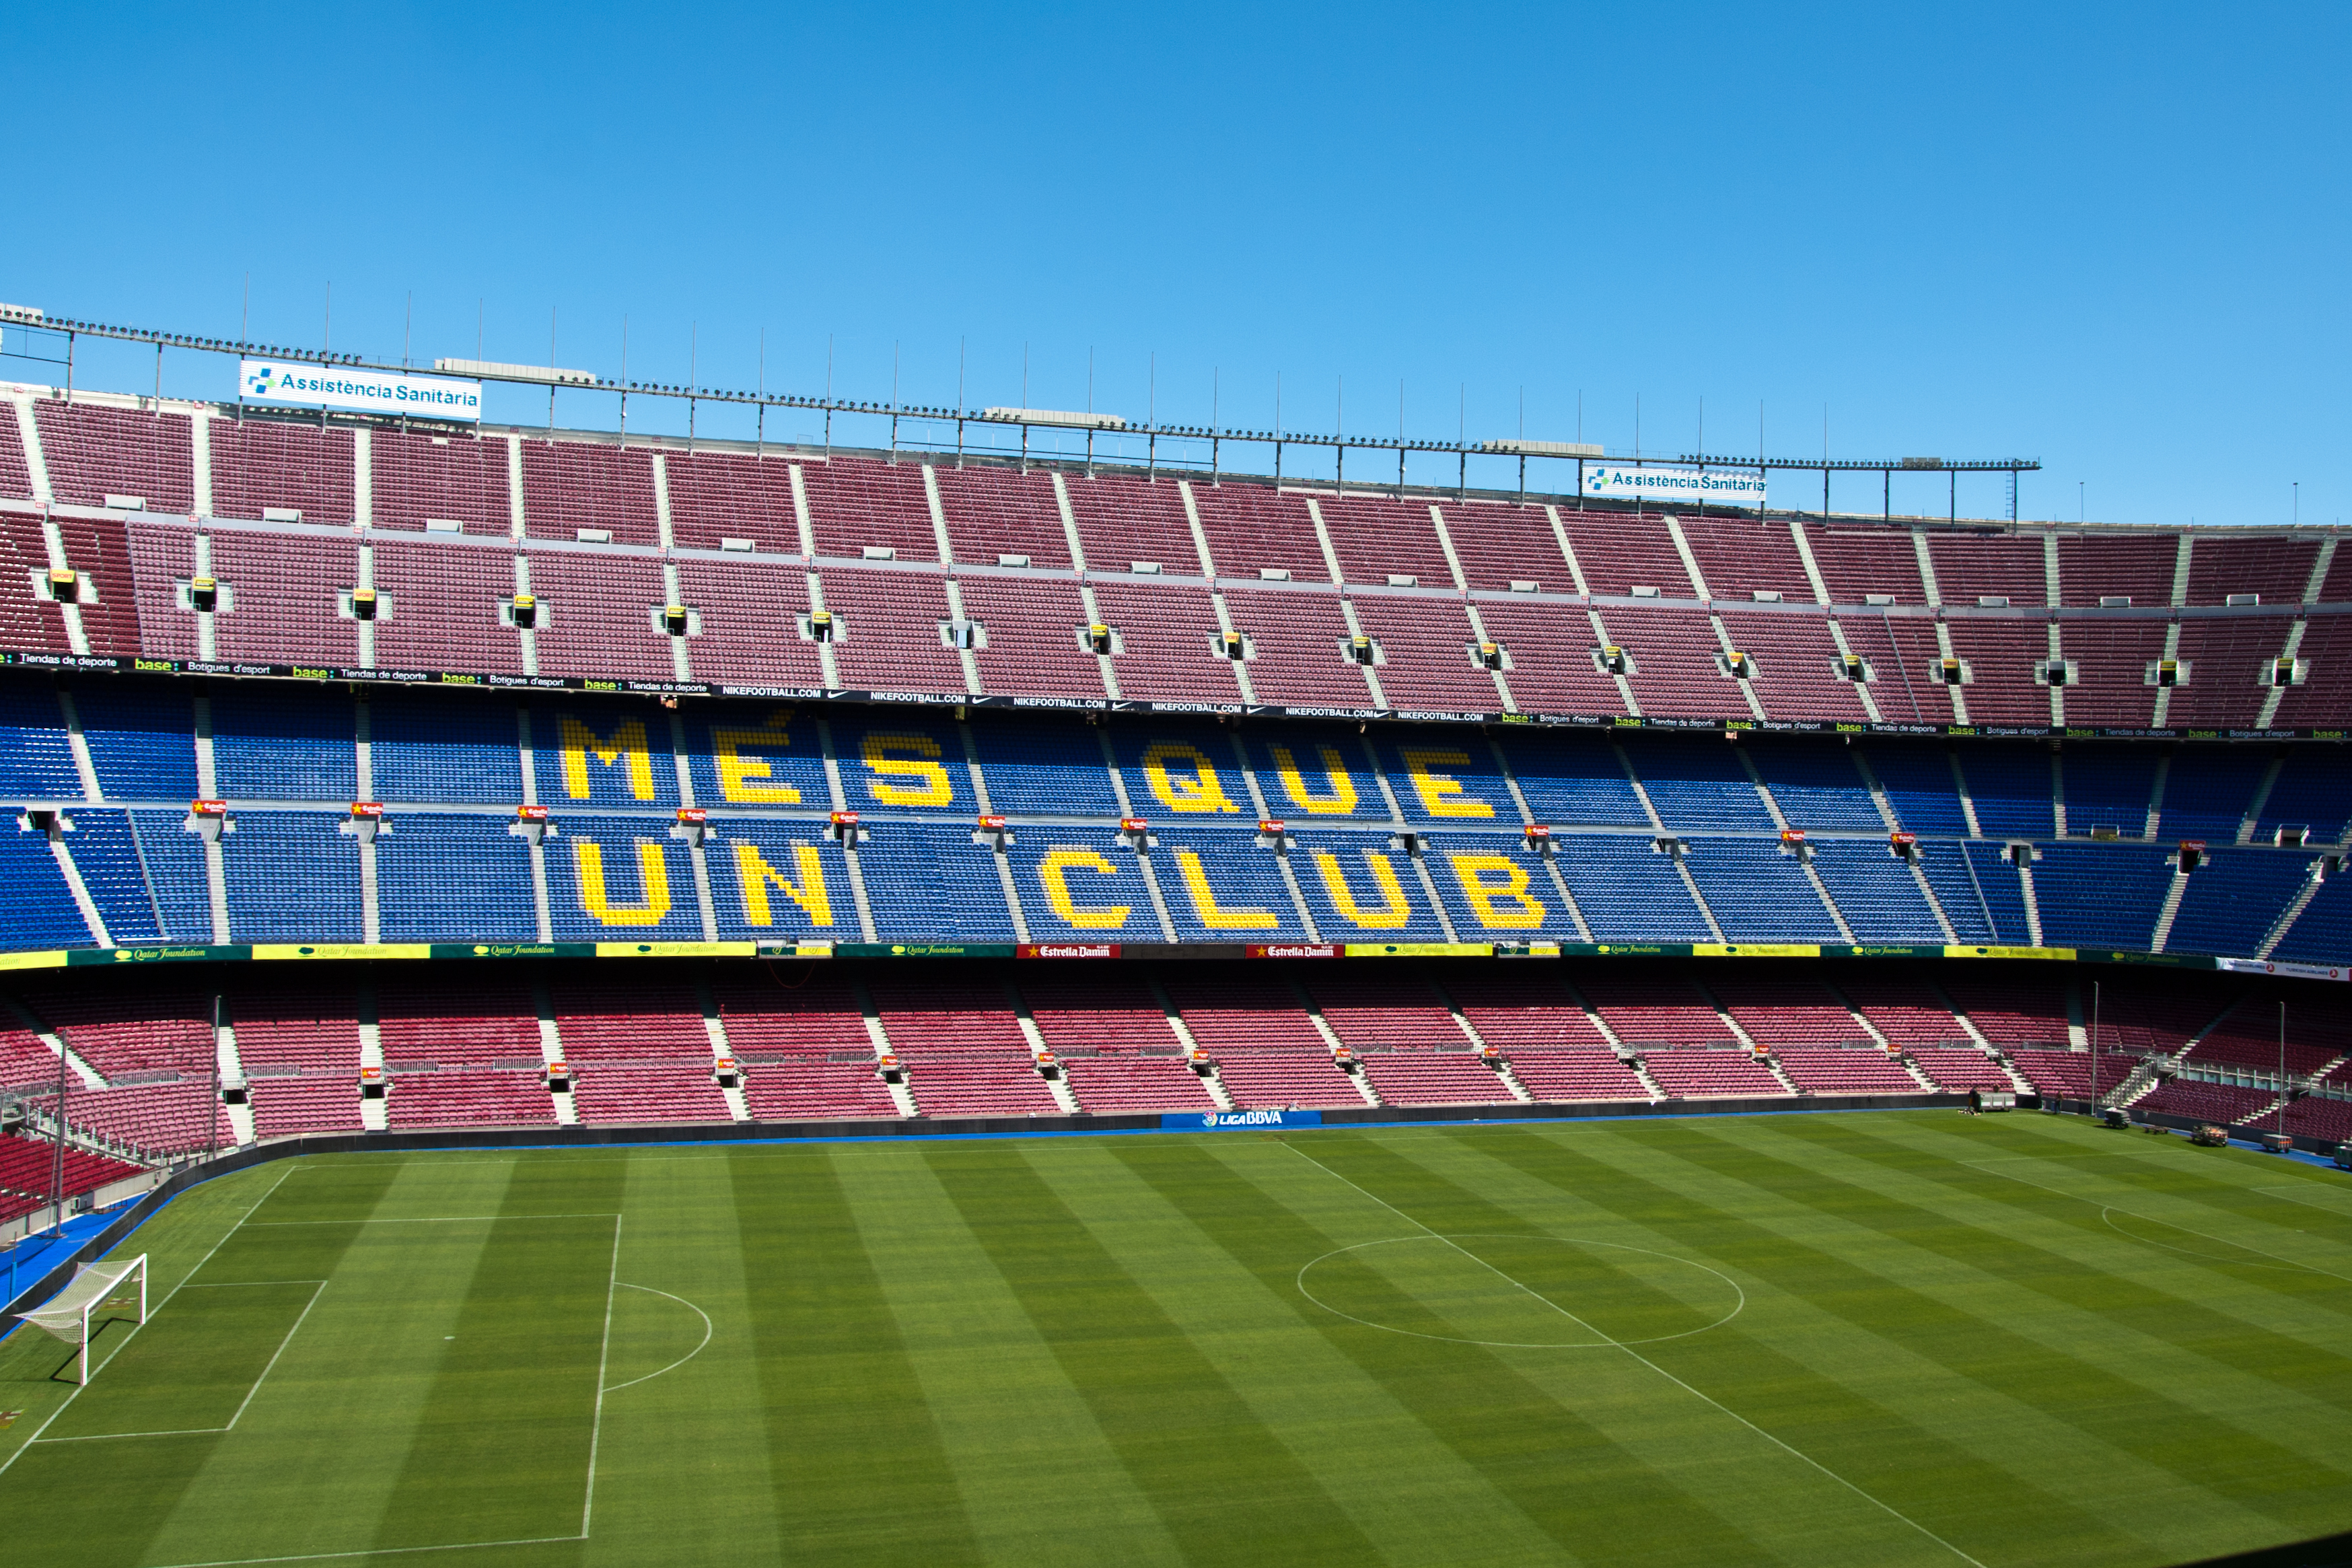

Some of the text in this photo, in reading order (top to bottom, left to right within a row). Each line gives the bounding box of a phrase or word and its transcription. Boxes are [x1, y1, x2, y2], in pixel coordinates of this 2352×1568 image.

[281, 373, 477, 406] Assistència Sanitària
[1613, 472, 1765, 491] Assistència Sanitària
[20, 653, 60, 664] Tiendas
[63, 656, 75, 666] de
[78, 657, 116, 667] deporte
[188, 662, 229, 674] Botigues
[234, 664, 270, 675] d'esport
[341, 669, 376, 678] Tiendas
[392, 672, 427, 681] deporte
[490, 675, 527, 686] Botigues
[530, 678, 564, 687] d'esport
[629, 682, 661, 690] Tiendas
[675, 684, 707, 692] deporte
[723, 686, 820, 697] NIKEFOOTBALL.COM
[871, 692, 966, 703] NIKEFOOTBALL.COM
[1013, 698, 1106, 709] NIKEFOOTBALL.COM
[1152, 703, 1242, 713] NIKEFOOTBALL.COM
[1286, 707, 1373, 719] NIKEFOOTBALL.COM
[1398, 711, 1483, 721] NIKEFOOTBALL.COM
[1540, 715, 1569, 723] Botigues
[1573, 715, 1599, 724] d'esport
[1689, 719, 1715, 727] deporte
[1763, 721, 1791, 730] Botigues
[1794, 722, 1820, 730] d'esport
[1987, 727, 2018, 736] Botigues
[2230, 729, 2262, 738] Botigues
[2265, 729, 2294, 738] d'esport
[1140, 738, 1495, 816] QUE
[571, 836, 1546, 928] UN CLUB
[135, 948, 205, 960] Qatar Foundation
[318, 946, 386, 957] Qatar Foundation
[491, 945, 555, 956] Qatar Foundation
[655, 944, 716, 954] Qatar Foundation
[907, 946, 964, 956] Qatar Foundation
[1040, 946, 1110, 957] Estrella Damm
[1268, 946, 1334, 957] Estrella Damm
[1399, 946, 1451, 954] Qatar Foundation
[1611, 945, 1661, 954] Qatar Foundation
[1865, 947, 1912, 956] Qatar Foundation
[1219, 1111, 1282, 1125] LIGA BBVA
